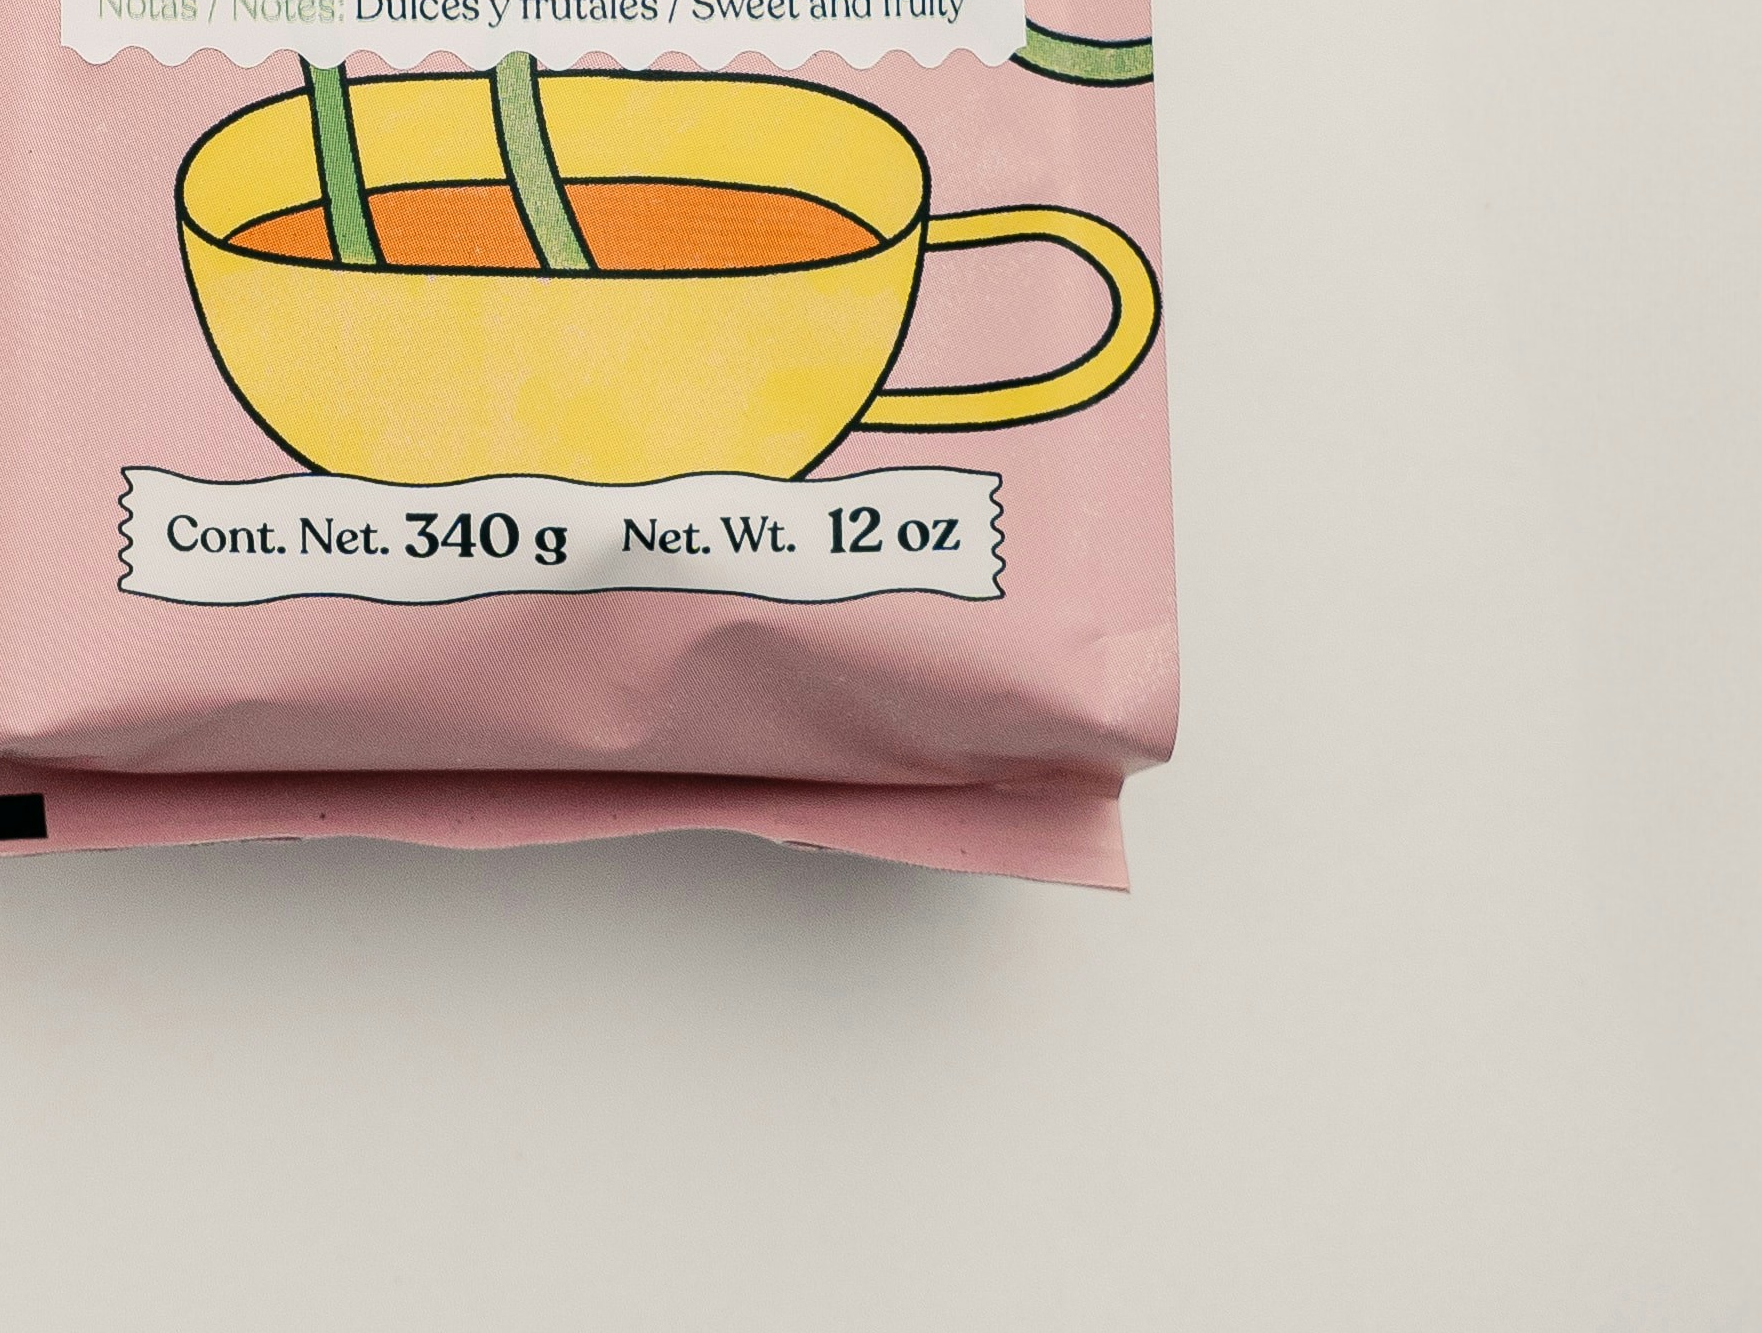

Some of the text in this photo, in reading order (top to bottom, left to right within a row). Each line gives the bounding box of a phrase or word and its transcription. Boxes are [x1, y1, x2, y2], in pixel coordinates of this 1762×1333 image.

[167, 506, 960, 565] Cont. Net. 340 g Net. Wt. 12 oz
